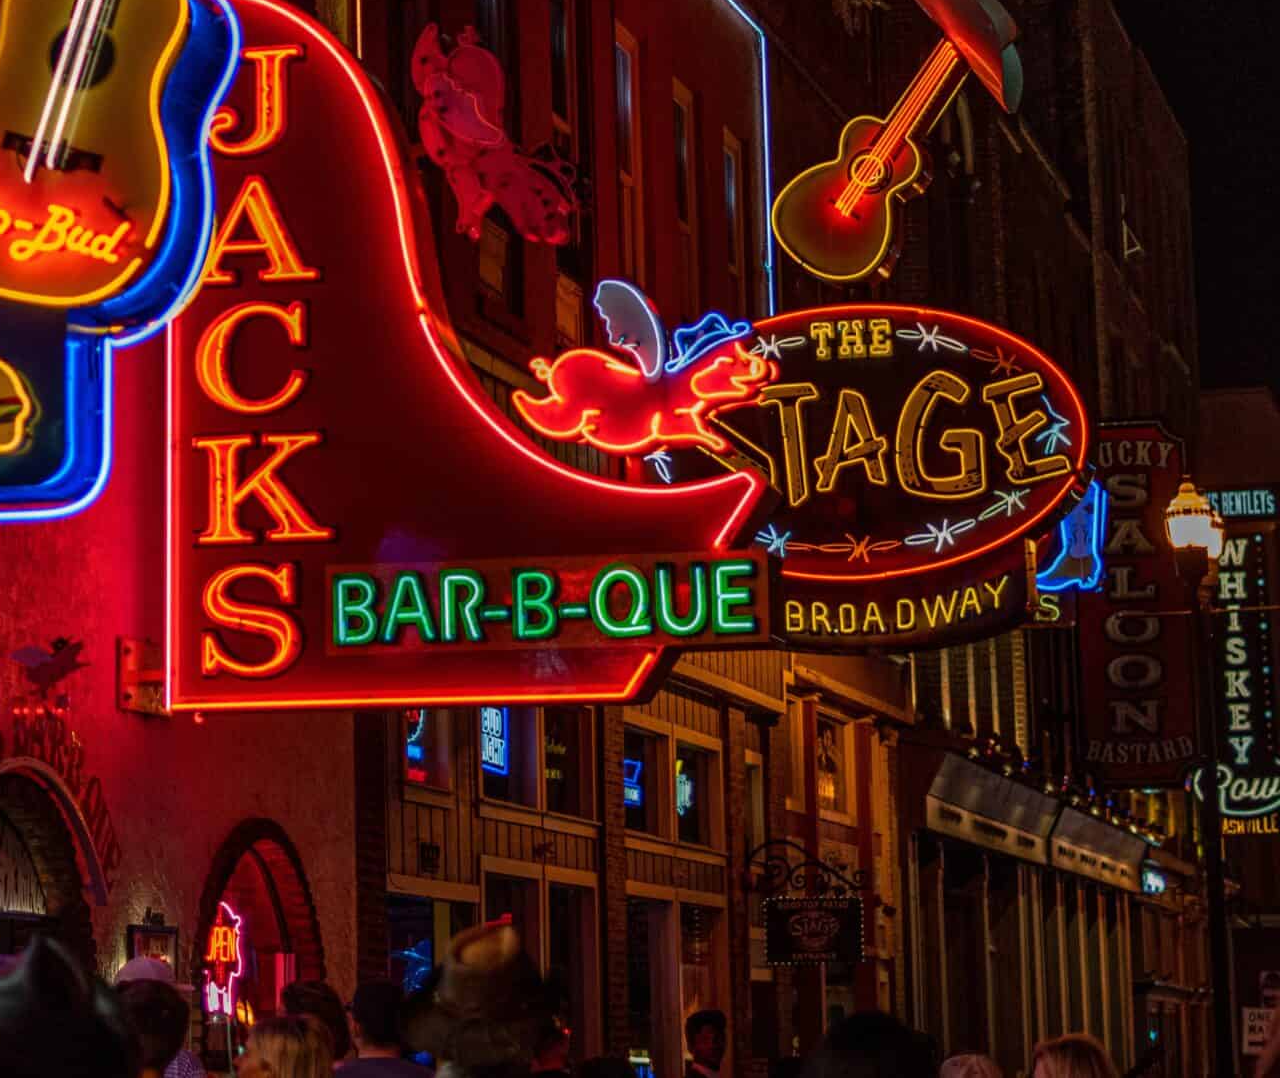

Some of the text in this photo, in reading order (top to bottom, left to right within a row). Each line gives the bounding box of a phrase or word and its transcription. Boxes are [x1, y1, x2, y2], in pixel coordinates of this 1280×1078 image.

[193, 43, 335, 680] JACKS
[809, 317, 893, 360] THE
[1096, 439, 1175, 469] UCKY
[332, 561, 756, 647] BAR-B-QUE
[784, 575, 1010, 635] BROADWAY
[1104, 473, 1162, 736] SALOON
[1217, 537, 1256, 766] WHISKEY
[1087, 734, 1193, 764] BASTARD
[1221, 816, 1280, 835] ASHVILLE
